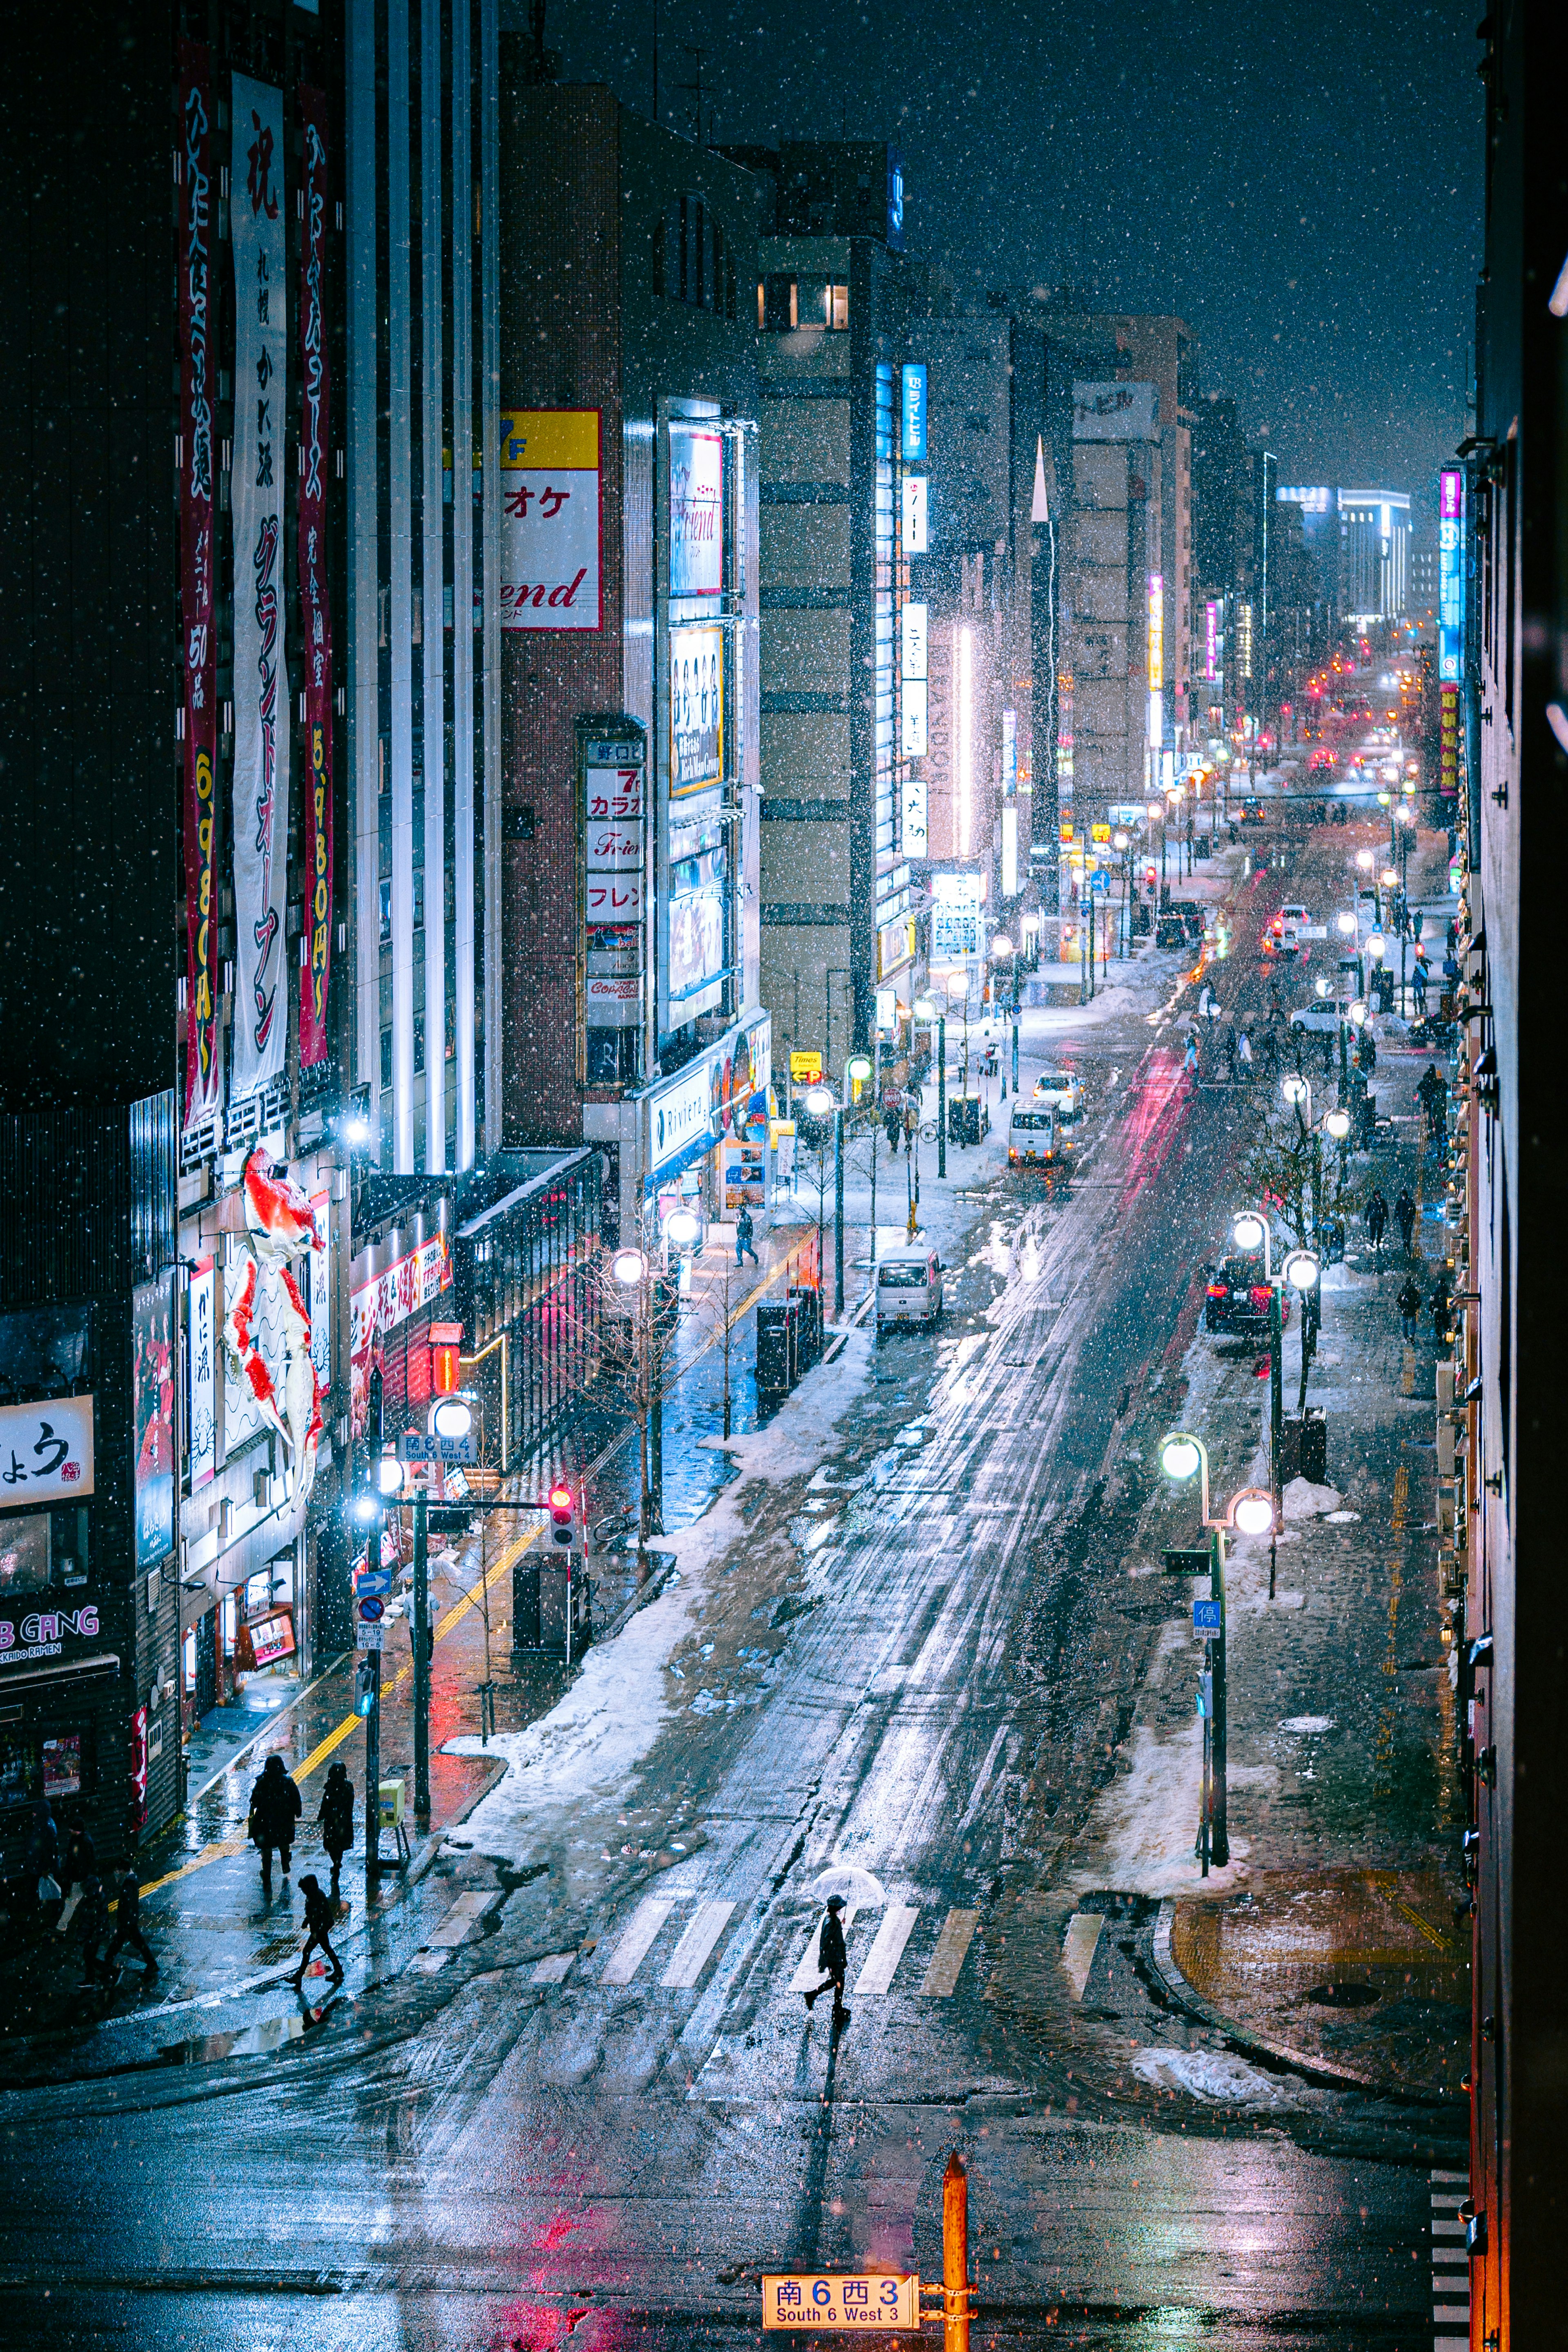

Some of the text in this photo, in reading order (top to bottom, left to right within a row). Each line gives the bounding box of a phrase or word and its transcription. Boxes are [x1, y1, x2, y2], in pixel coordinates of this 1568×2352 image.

[247, 108, 278, 219] 祝
[198, 1286, 210, 1382] かに源
[20, 1606, 99, 1642] GANG
[1198, 1605, 1216, 1623] 停
[28, 1643, 61, 1657] RAMEN
[777, 2308, 898, 2321] South 6 West 3
